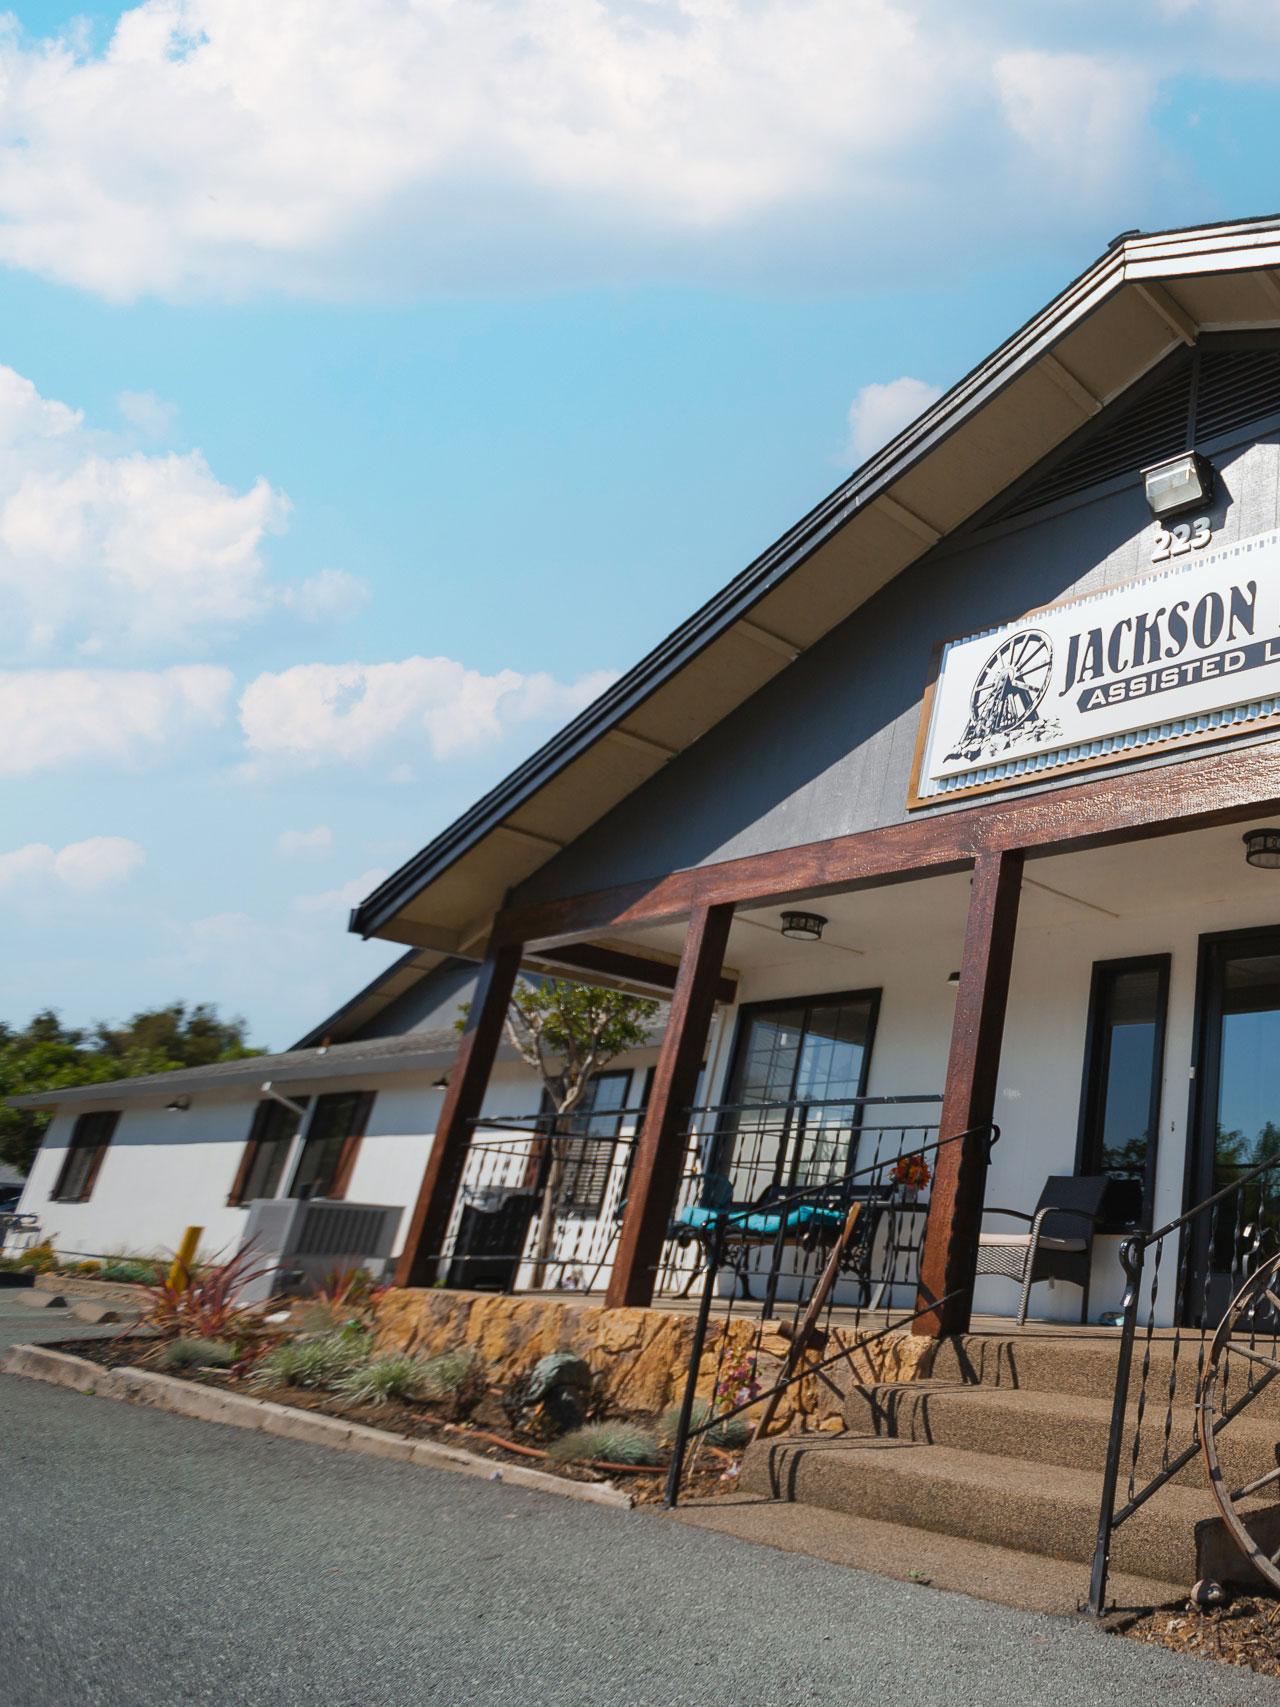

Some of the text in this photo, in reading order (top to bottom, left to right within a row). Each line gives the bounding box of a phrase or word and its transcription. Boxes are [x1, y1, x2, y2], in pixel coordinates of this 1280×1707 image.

[1152, 517, 1212, 563] 223
[1058, 580, 1257, 697] JACKSON
[1087, 650, 1247, 709] ASSISTED
